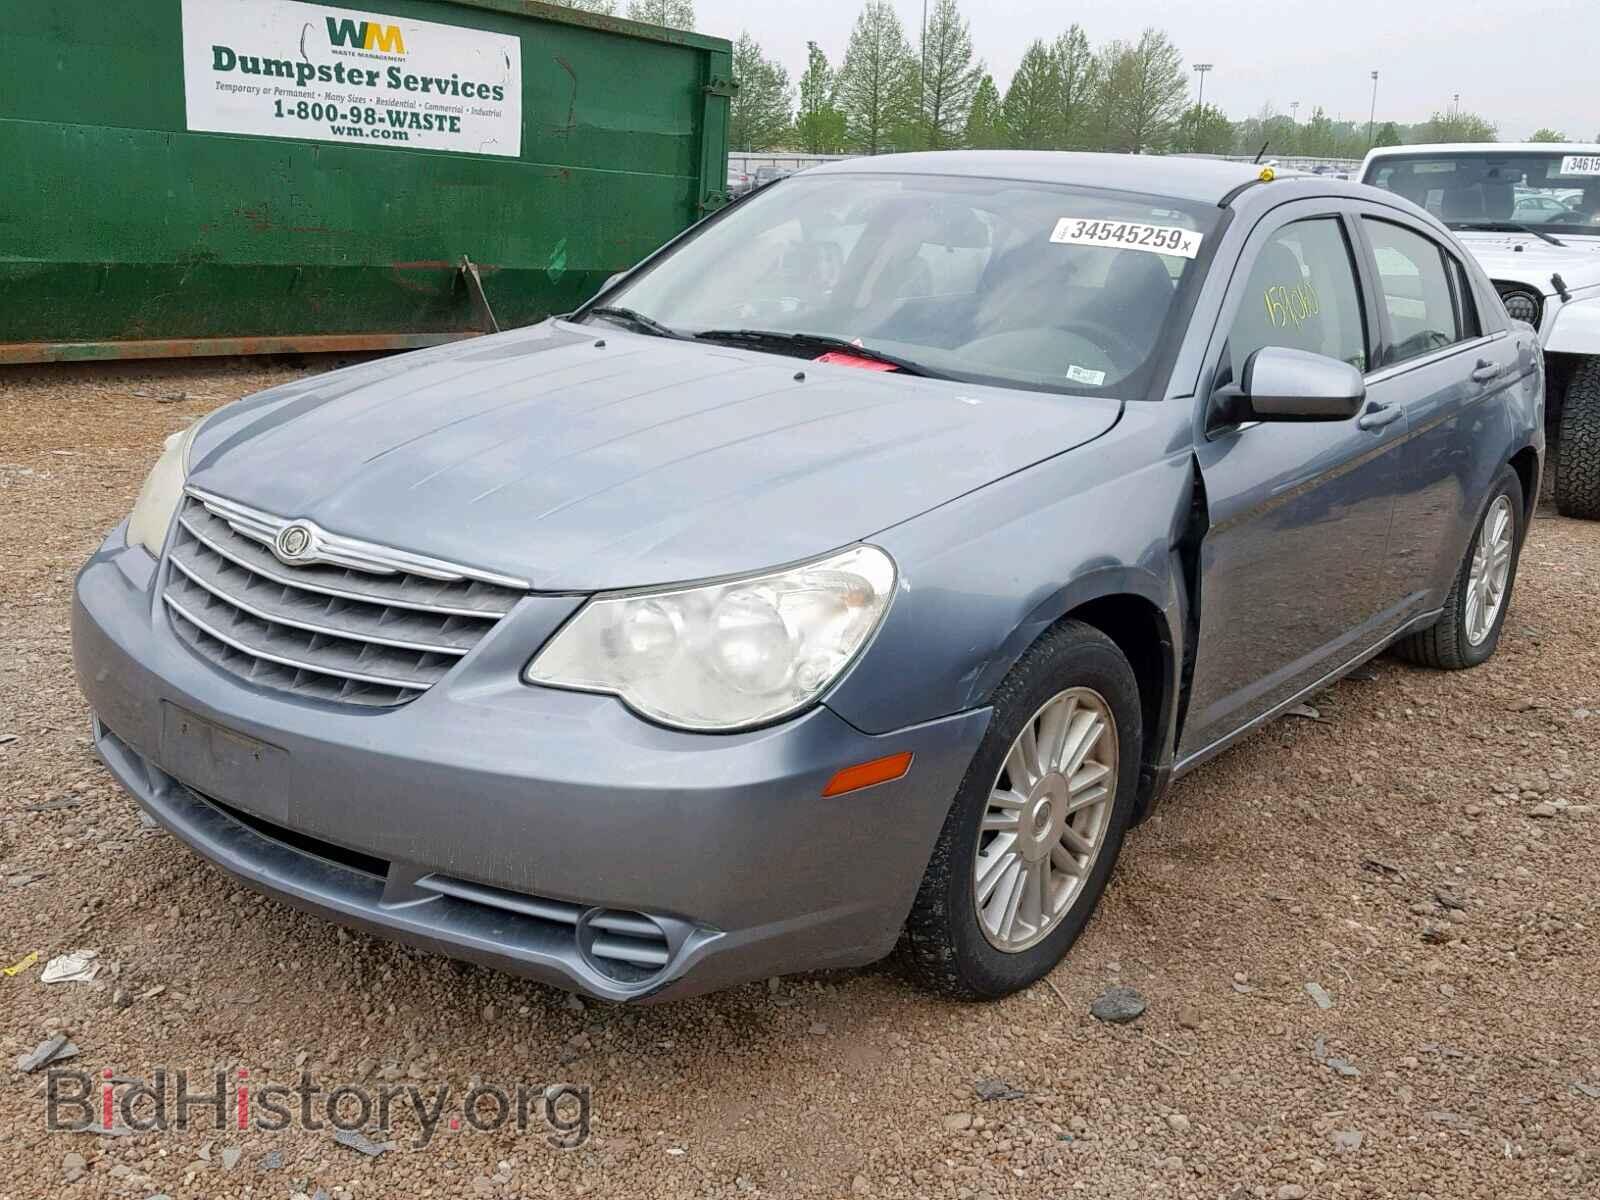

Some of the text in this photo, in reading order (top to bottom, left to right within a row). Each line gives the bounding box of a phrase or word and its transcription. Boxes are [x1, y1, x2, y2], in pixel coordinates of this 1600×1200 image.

[331, 49, 356, 57] WASTE
[212, 45, 504, 101] Dumpster Services
[215, 81, 260, 95] Temporary
[274, 87, 315, 98] Permanent
[324, 92, 345, 104] Many
[347, 94, 367, 104] Sizes
[376, 96, 416, 109] Residential
[424, 102, 464, 114] Commercial
[471, 106, 502, 118] Industrial
[274, 99, 461, 133] 1-800-98-WASTE
[330, 125, 409, 140] wm.com
